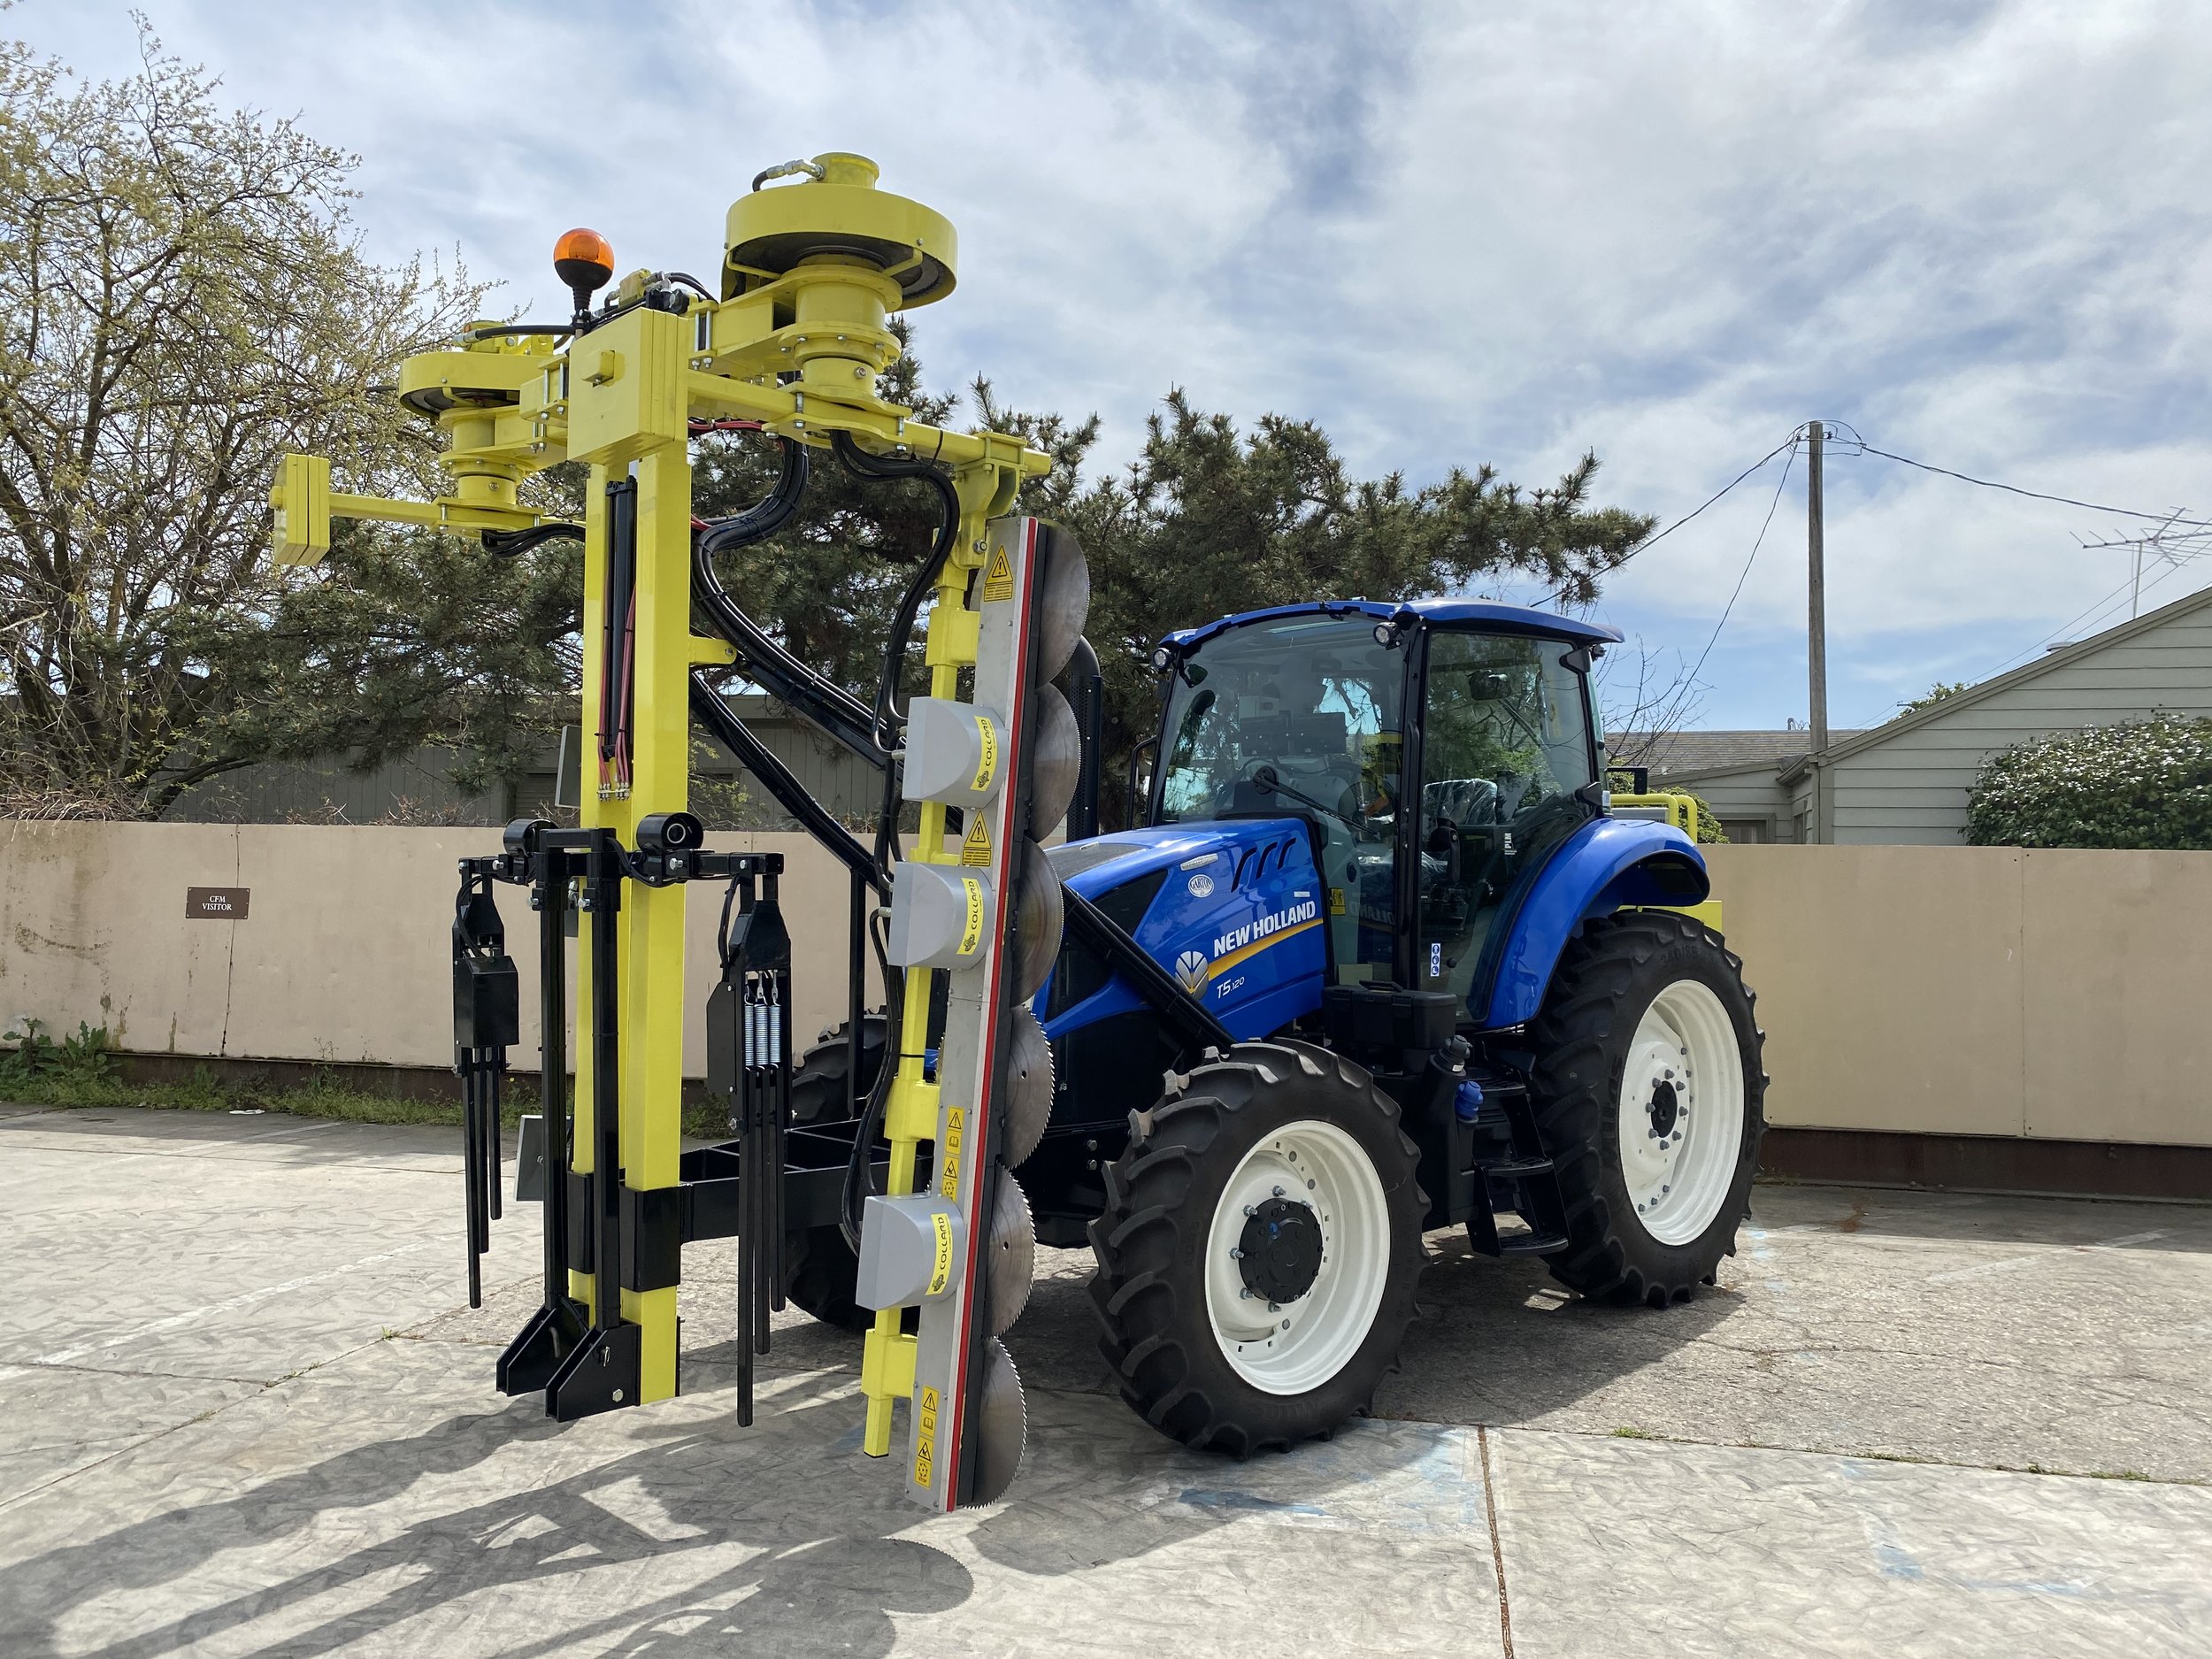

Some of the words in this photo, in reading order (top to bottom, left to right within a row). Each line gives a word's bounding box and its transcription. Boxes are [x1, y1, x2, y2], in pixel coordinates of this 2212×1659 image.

[980, 718, 992, 766] COLLARD
[968, 880, 979, 930] COLLARD
[1213, 924, 1250, 958] NEW
[1253, 900, 1316, 940] HOLLAND
[938, 1217, 948, 1270] COLLARD
